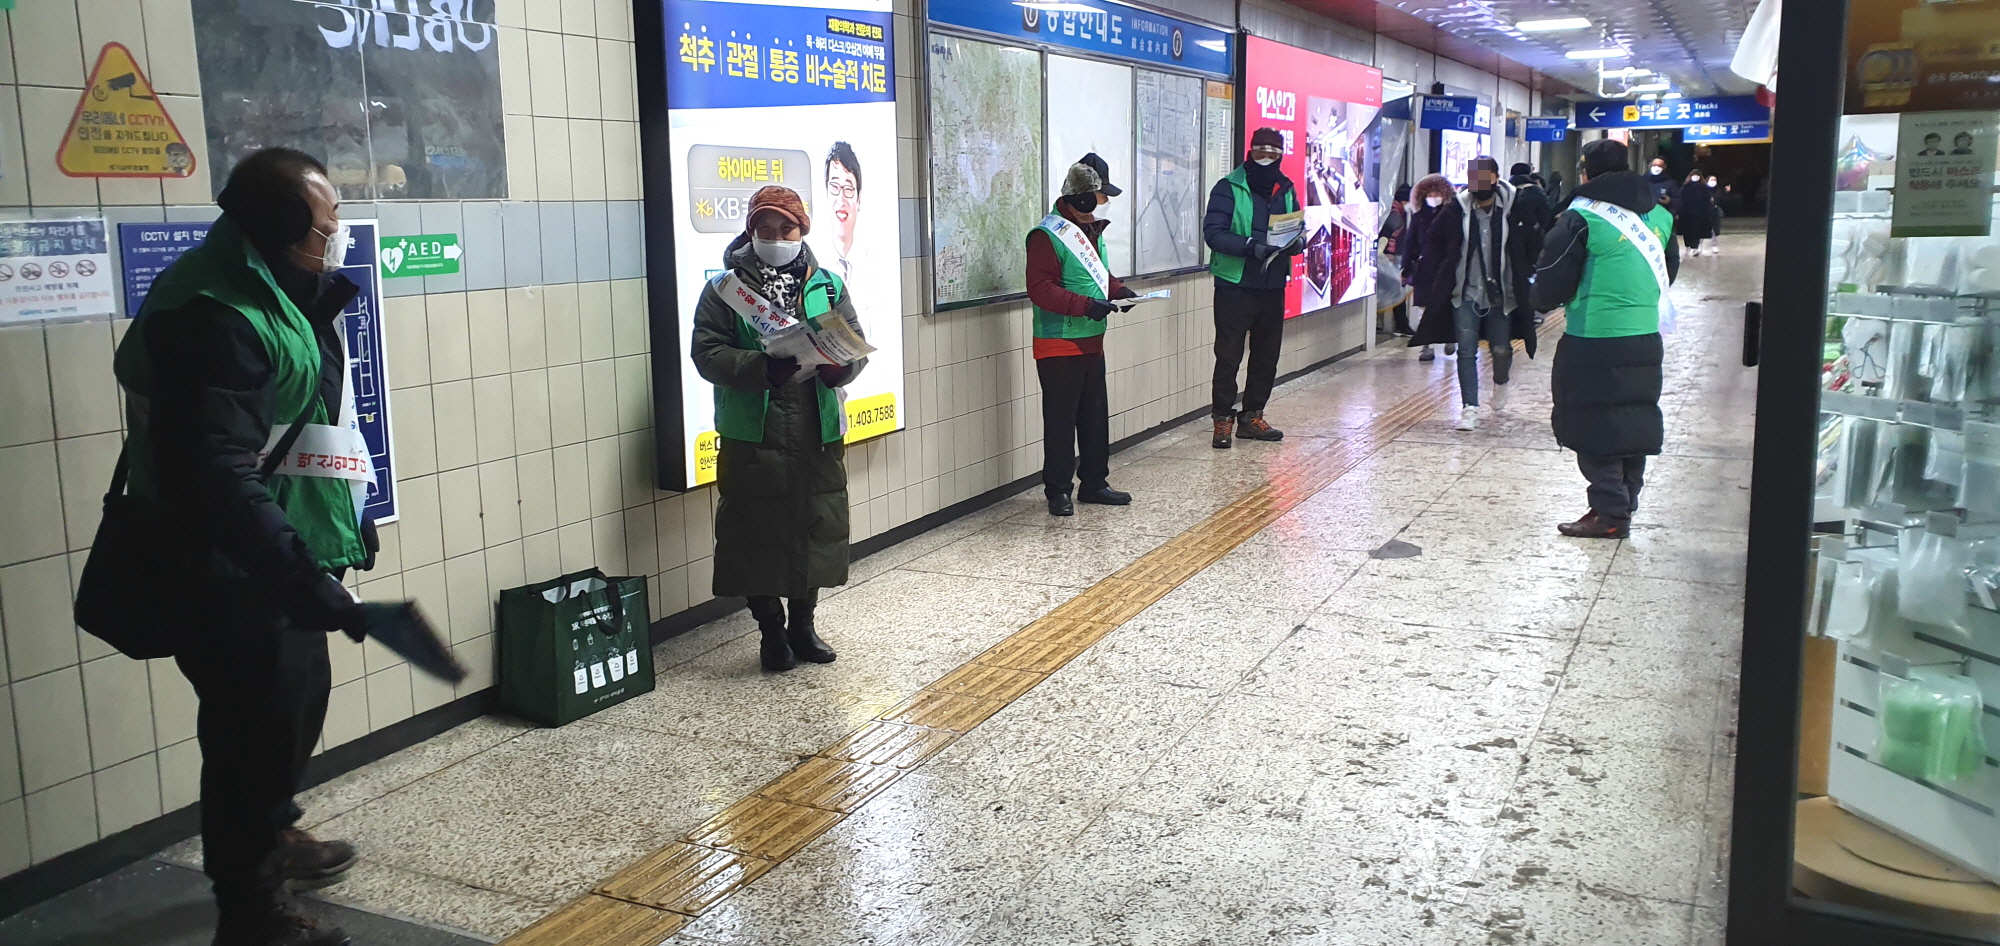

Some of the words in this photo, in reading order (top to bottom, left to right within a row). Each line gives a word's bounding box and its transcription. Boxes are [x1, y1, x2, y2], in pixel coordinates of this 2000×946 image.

[871, 26, 883, 40] 진료
[1131, 17, 1168, 37] INFORMATION
[679, 32, 716, 73] 척추
[726, 41, 759, 79] 관절
[769, 48, 800, 84] 통증
[805, 54, 859, 91] 비수술적
[861, 61, 886, 93] 치료
[1676, 103, 1691, 120] 곳
[1694, 102, 1718, 111] Tracks
[81, 110, 126, 126] 우리동네
[127, 113, 165, 126] CCTV가
[77, 126, 112, 141] 안전을
[115, 130, 169, 142] 지켜드립니다
[718, 156, 769, 183] 하이마트
[770, 158, 784, 183] 뒤
[1606, 205, 1628, 222] 경기
[173, 230, 190, 242] 설치
[407, 241, 442, 257] AED
[736, 286, 757, 306] 생활
[756, 304, 769, 314] 속
[768, 310, 792, 329] 방역
[848, 403, 895, 429] 1.403.7588
[699, 439, 713, 452] 버스
[297, 452, 367, 474] 백신입니다
